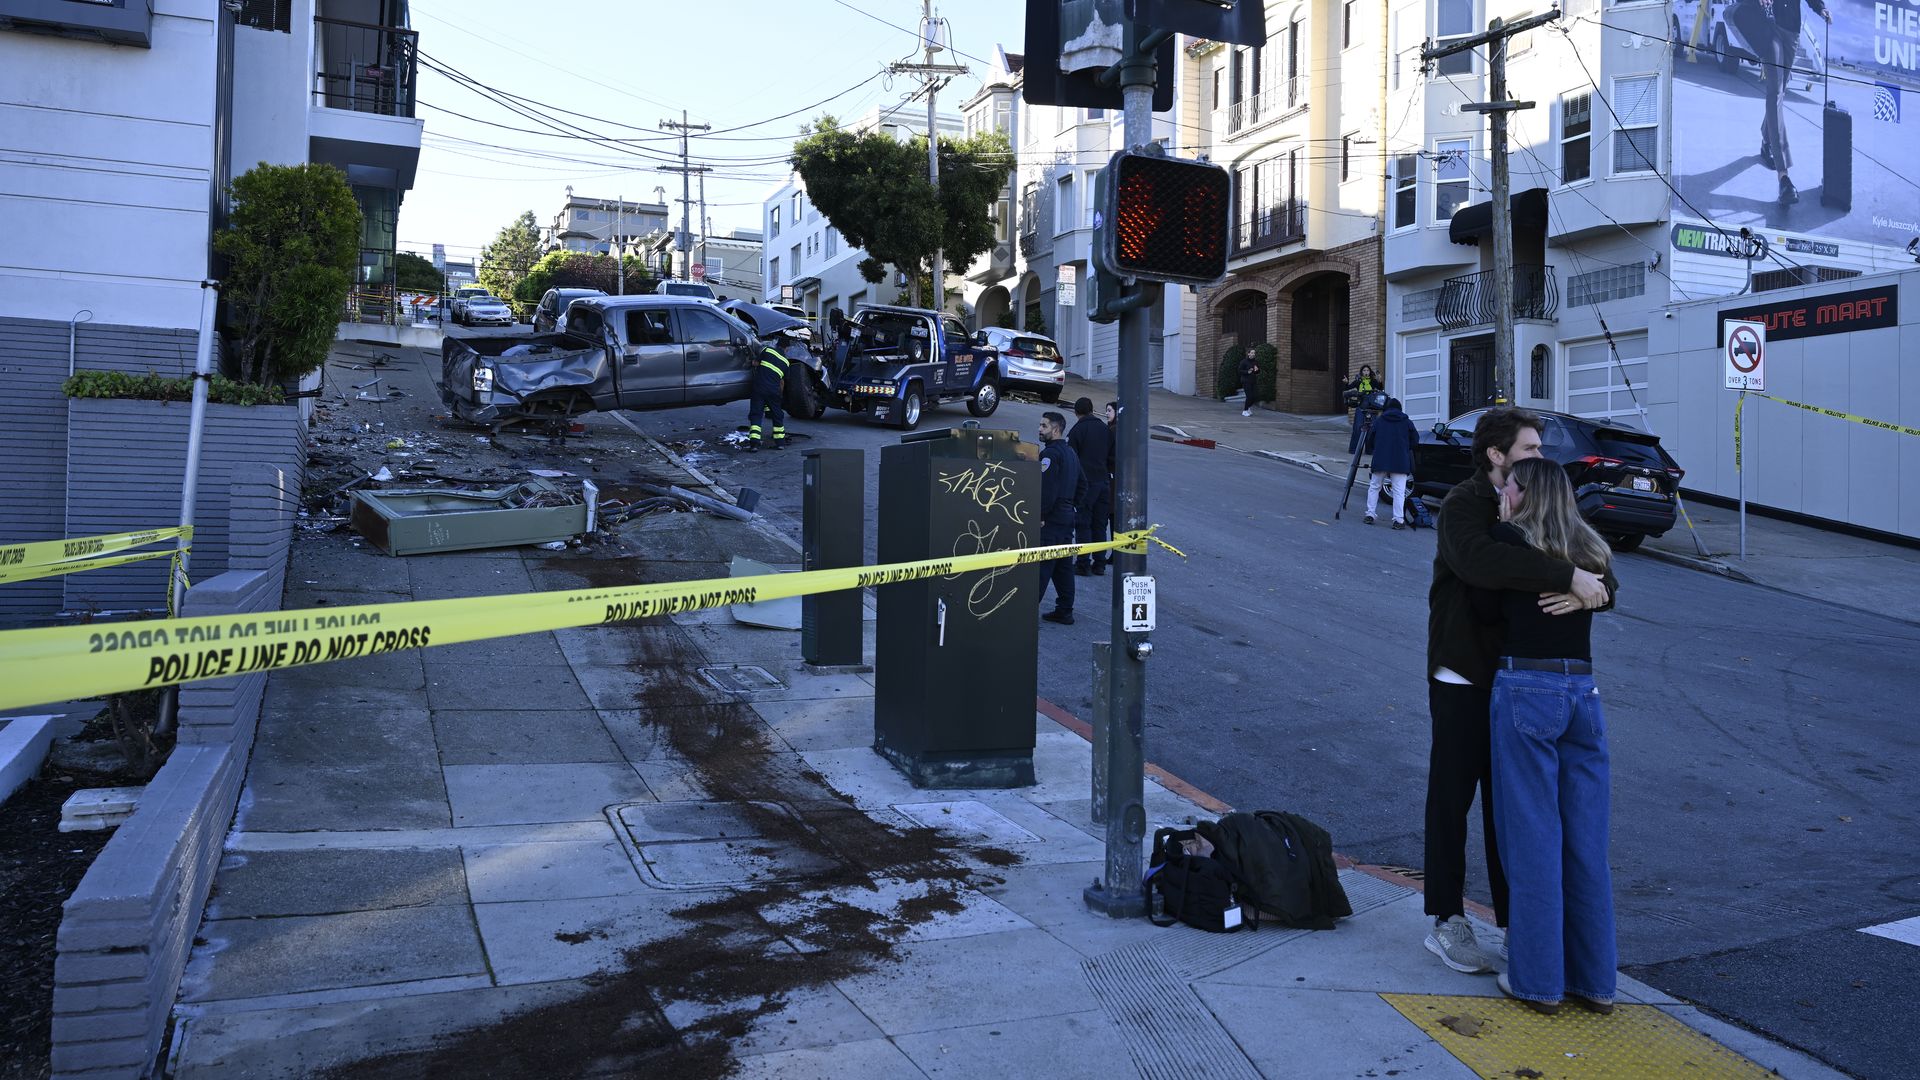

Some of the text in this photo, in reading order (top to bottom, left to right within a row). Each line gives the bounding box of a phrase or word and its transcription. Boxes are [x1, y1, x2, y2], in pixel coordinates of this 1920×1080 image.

[1875, 2, 1920, 38] FLIE
[1874, 35, 1920, 71] UNI
[1816, 297, 1888, 324] MART
[1728, 376, 1762, 386] OVER 3 TONS
[856, 562, 952, 586] POLICE LINE DO NOT CROSS
[602, 600, 649, 624] POLICE
[650, 597, 678, 616] LINE
[678, 594, 697, 612] DO
[697, 592, 722, 610] NOT
[722, 587, 756, 606] CROSS
[1128, 588, 1152, 596] BUTTON
[144, 626, 431, 686] POLICE LINE DO NOT CROSS
